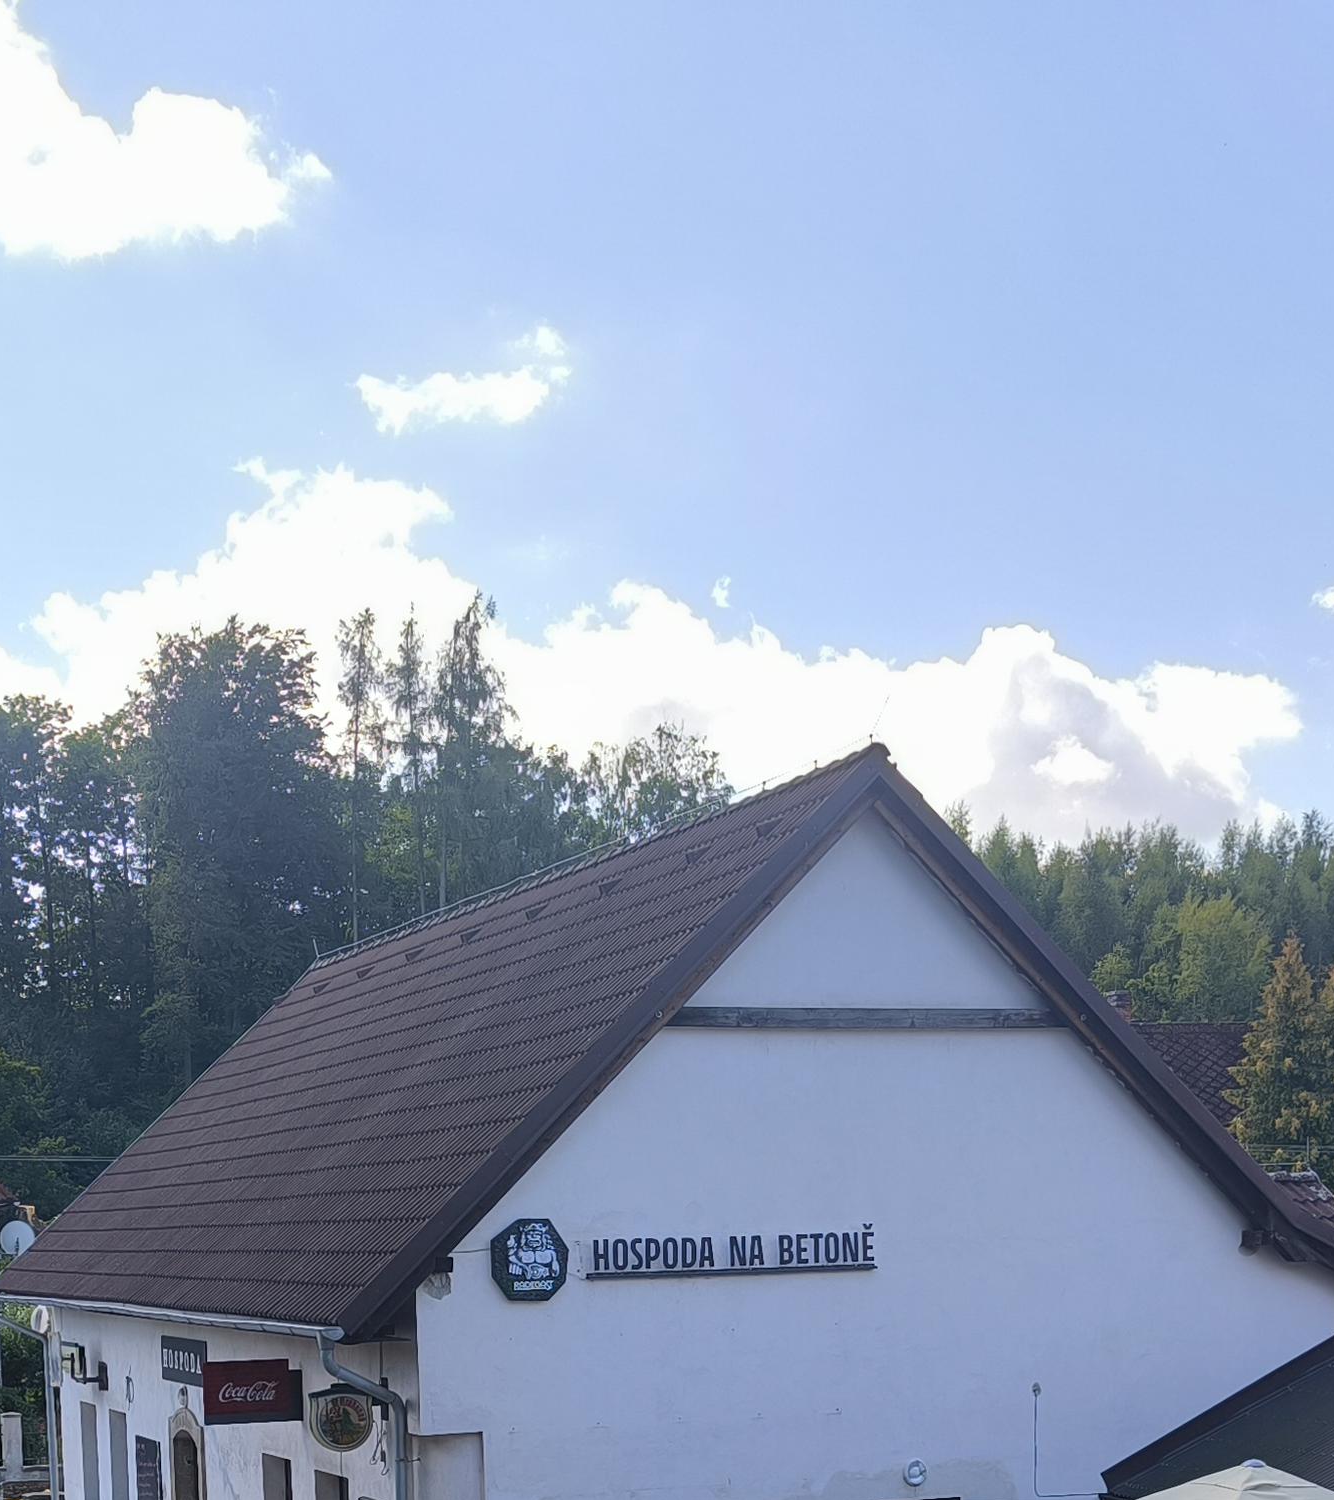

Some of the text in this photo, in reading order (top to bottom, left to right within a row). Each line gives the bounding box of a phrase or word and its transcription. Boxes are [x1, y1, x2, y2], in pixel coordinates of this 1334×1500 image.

[593, 1223, 875, 1271] HOSPODA NA BETONĚ
[162, 1348, 203, 1375] HOSPODA
